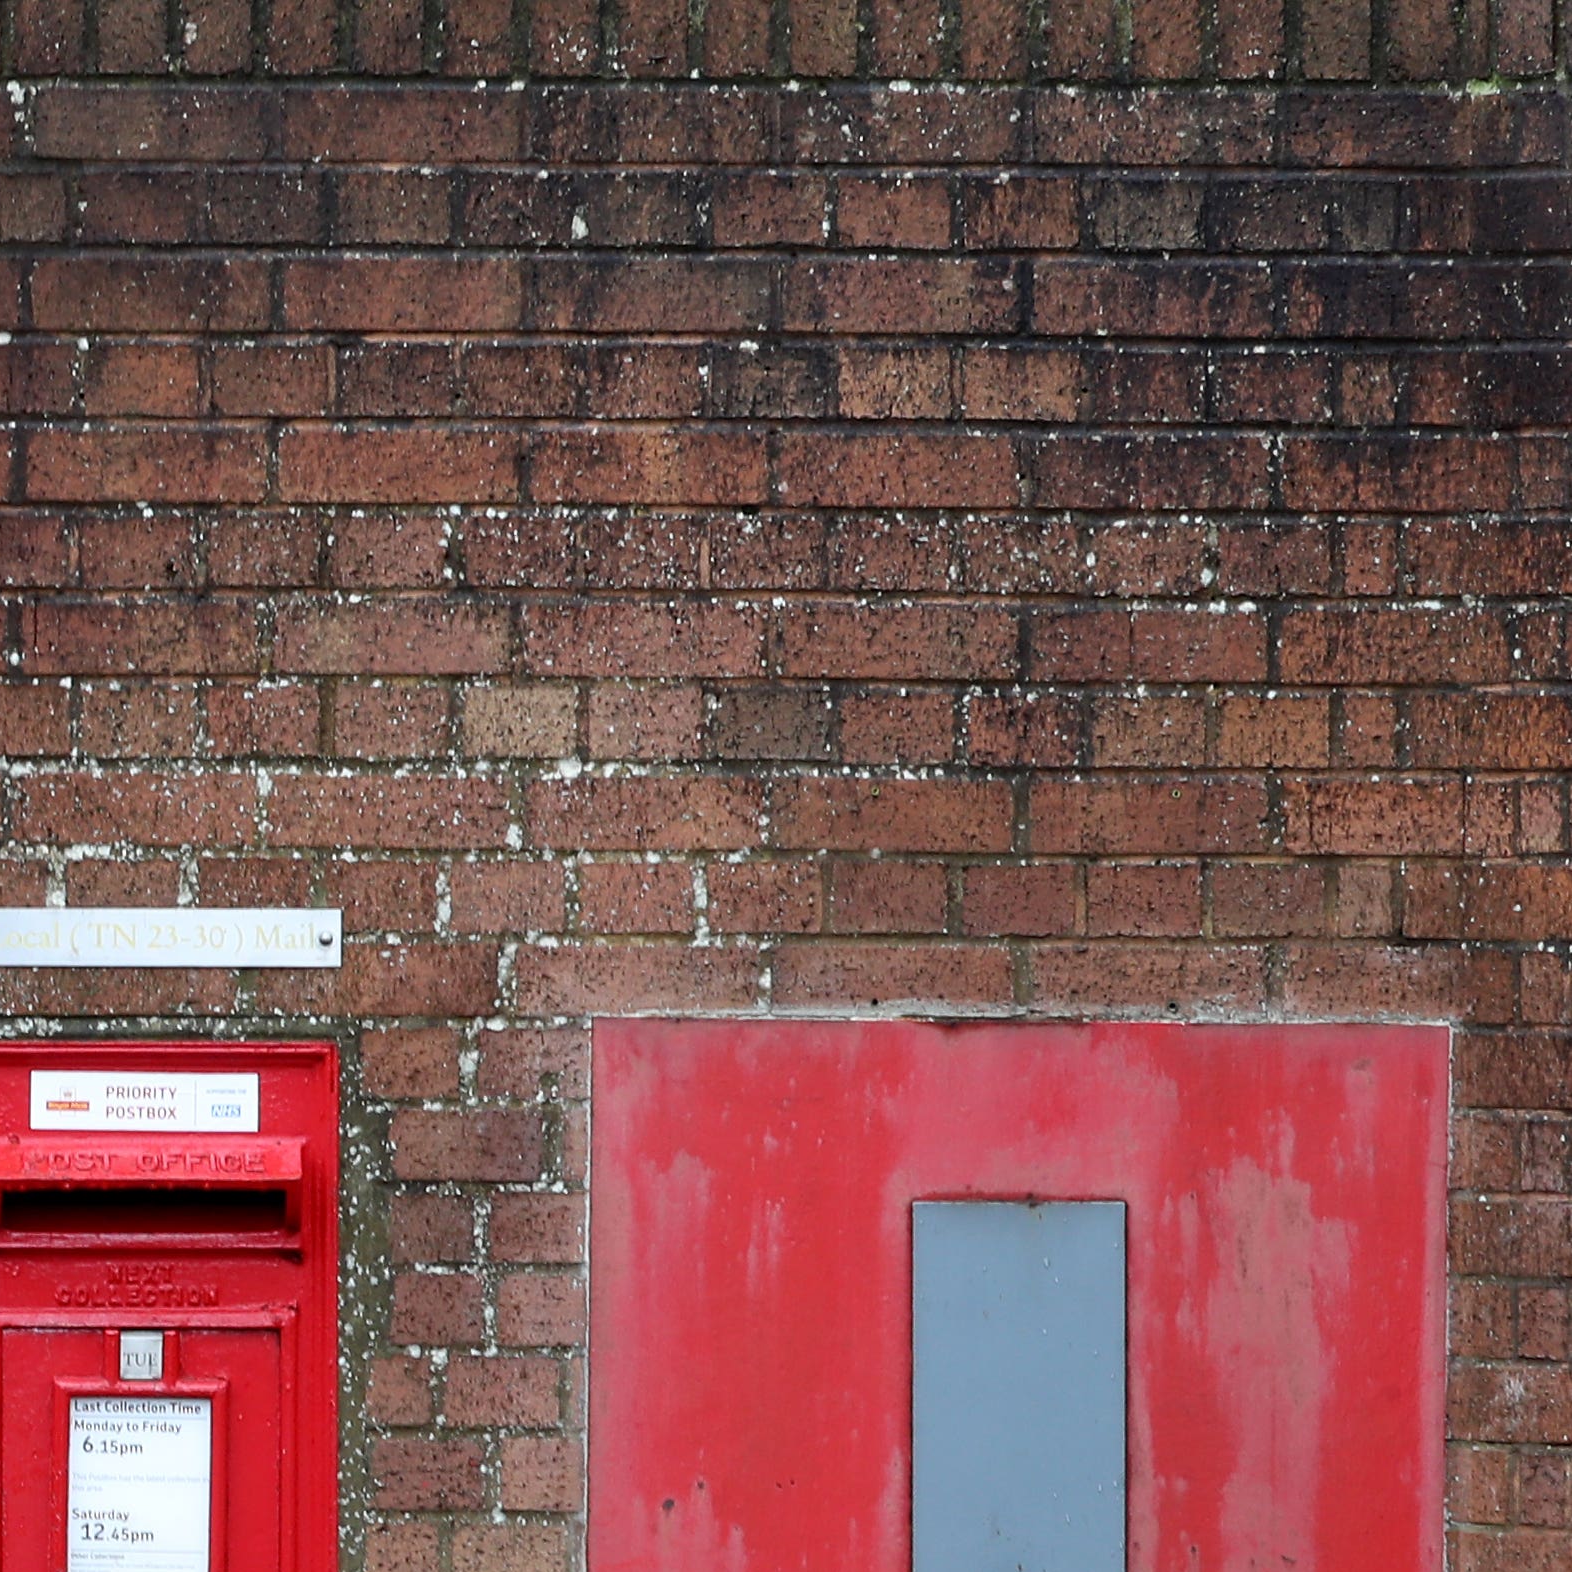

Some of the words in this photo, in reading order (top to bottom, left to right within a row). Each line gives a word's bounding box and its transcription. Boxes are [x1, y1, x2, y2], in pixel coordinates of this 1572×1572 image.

[255, 923, 316, 949] Mail
[106, 1086, 177, 1100] PRIORITY
[106, 1106, 177, 1120] POSTBOX
[22, 1153, 117, 1172] POST
[136, 1152, 265, 1173] OFFICE
[55, 1286, 219, 1307] COLLECTION
[74, 1400, 101, 1414] Last
[104, 1401, 167, 1415] Collection
[170, 1402, 202, 1415] Time
[74, 1420, 124, 1434] Monday
[127, 1422, 139, 1433] to
[142, 1421, 182, 1435] Friday
[82, 1435, 144, 1456] 6.15pm
[72, 1507, 130, 1522] Saturday
[80, 1522, 155, 1544] 12.45pm
